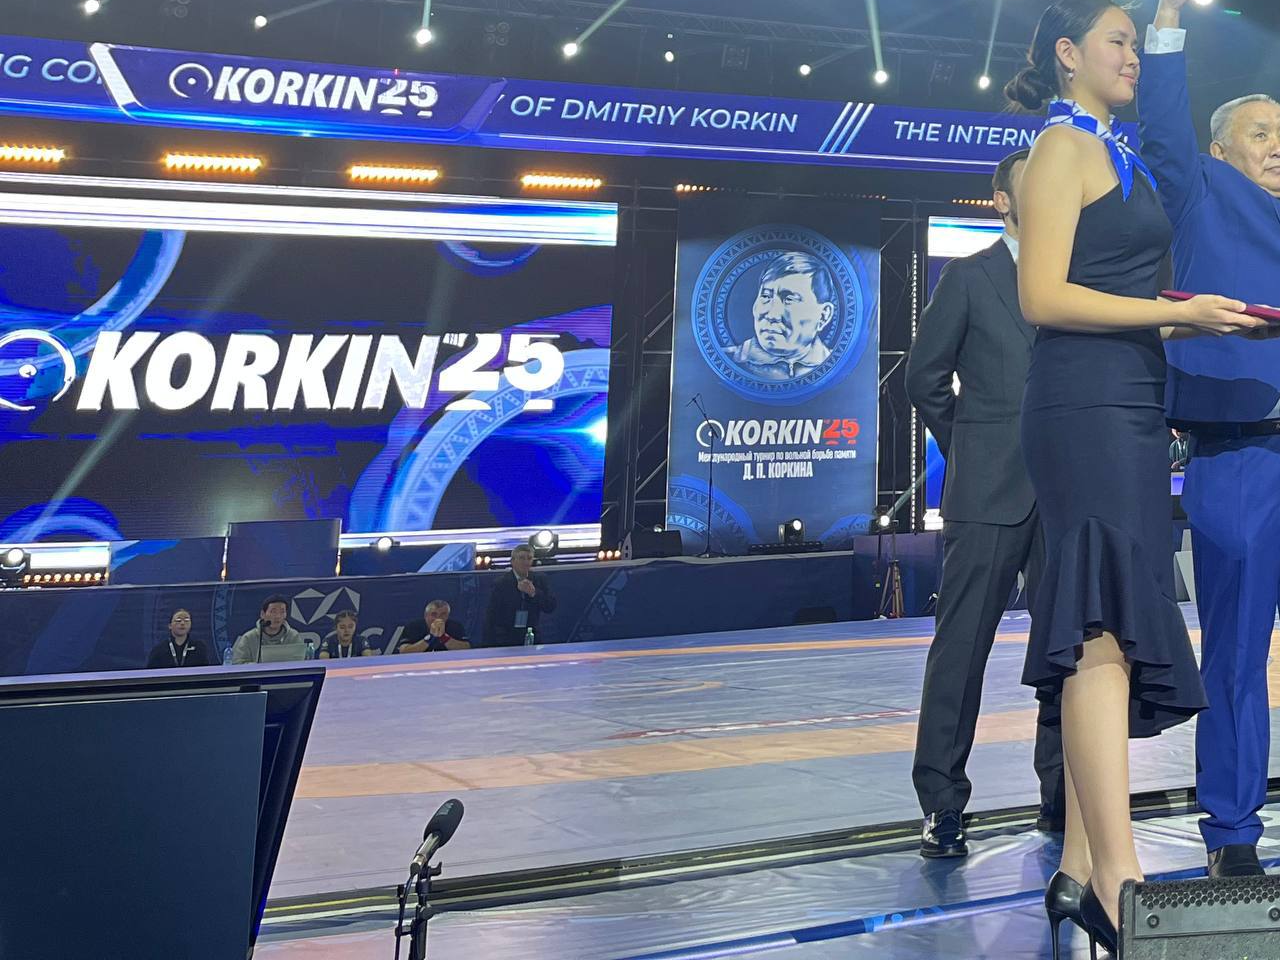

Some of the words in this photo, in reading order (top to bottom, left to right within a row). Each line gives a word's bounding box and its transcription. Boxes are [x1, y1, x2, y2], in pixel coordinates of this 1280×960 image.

[0, 53, 33, 78] G
[41, 58, 103, 85] CO
[213, 65, 378, 111] KORKIN
[510, 95, 555, 118] OF
[560, 97, 687, 125] DMITRIY
[690, 107, 798, 134] KORKIN
[894, 119, 941, 142] THE
[76, 331, 441, 413] KORKIN
[724, 419, 824, 446] KORKIN
[742, 462, 754, 481] Д.
[756, 462, 766, 479] П.
[768, 461, 814, 479] КОРКИНА
